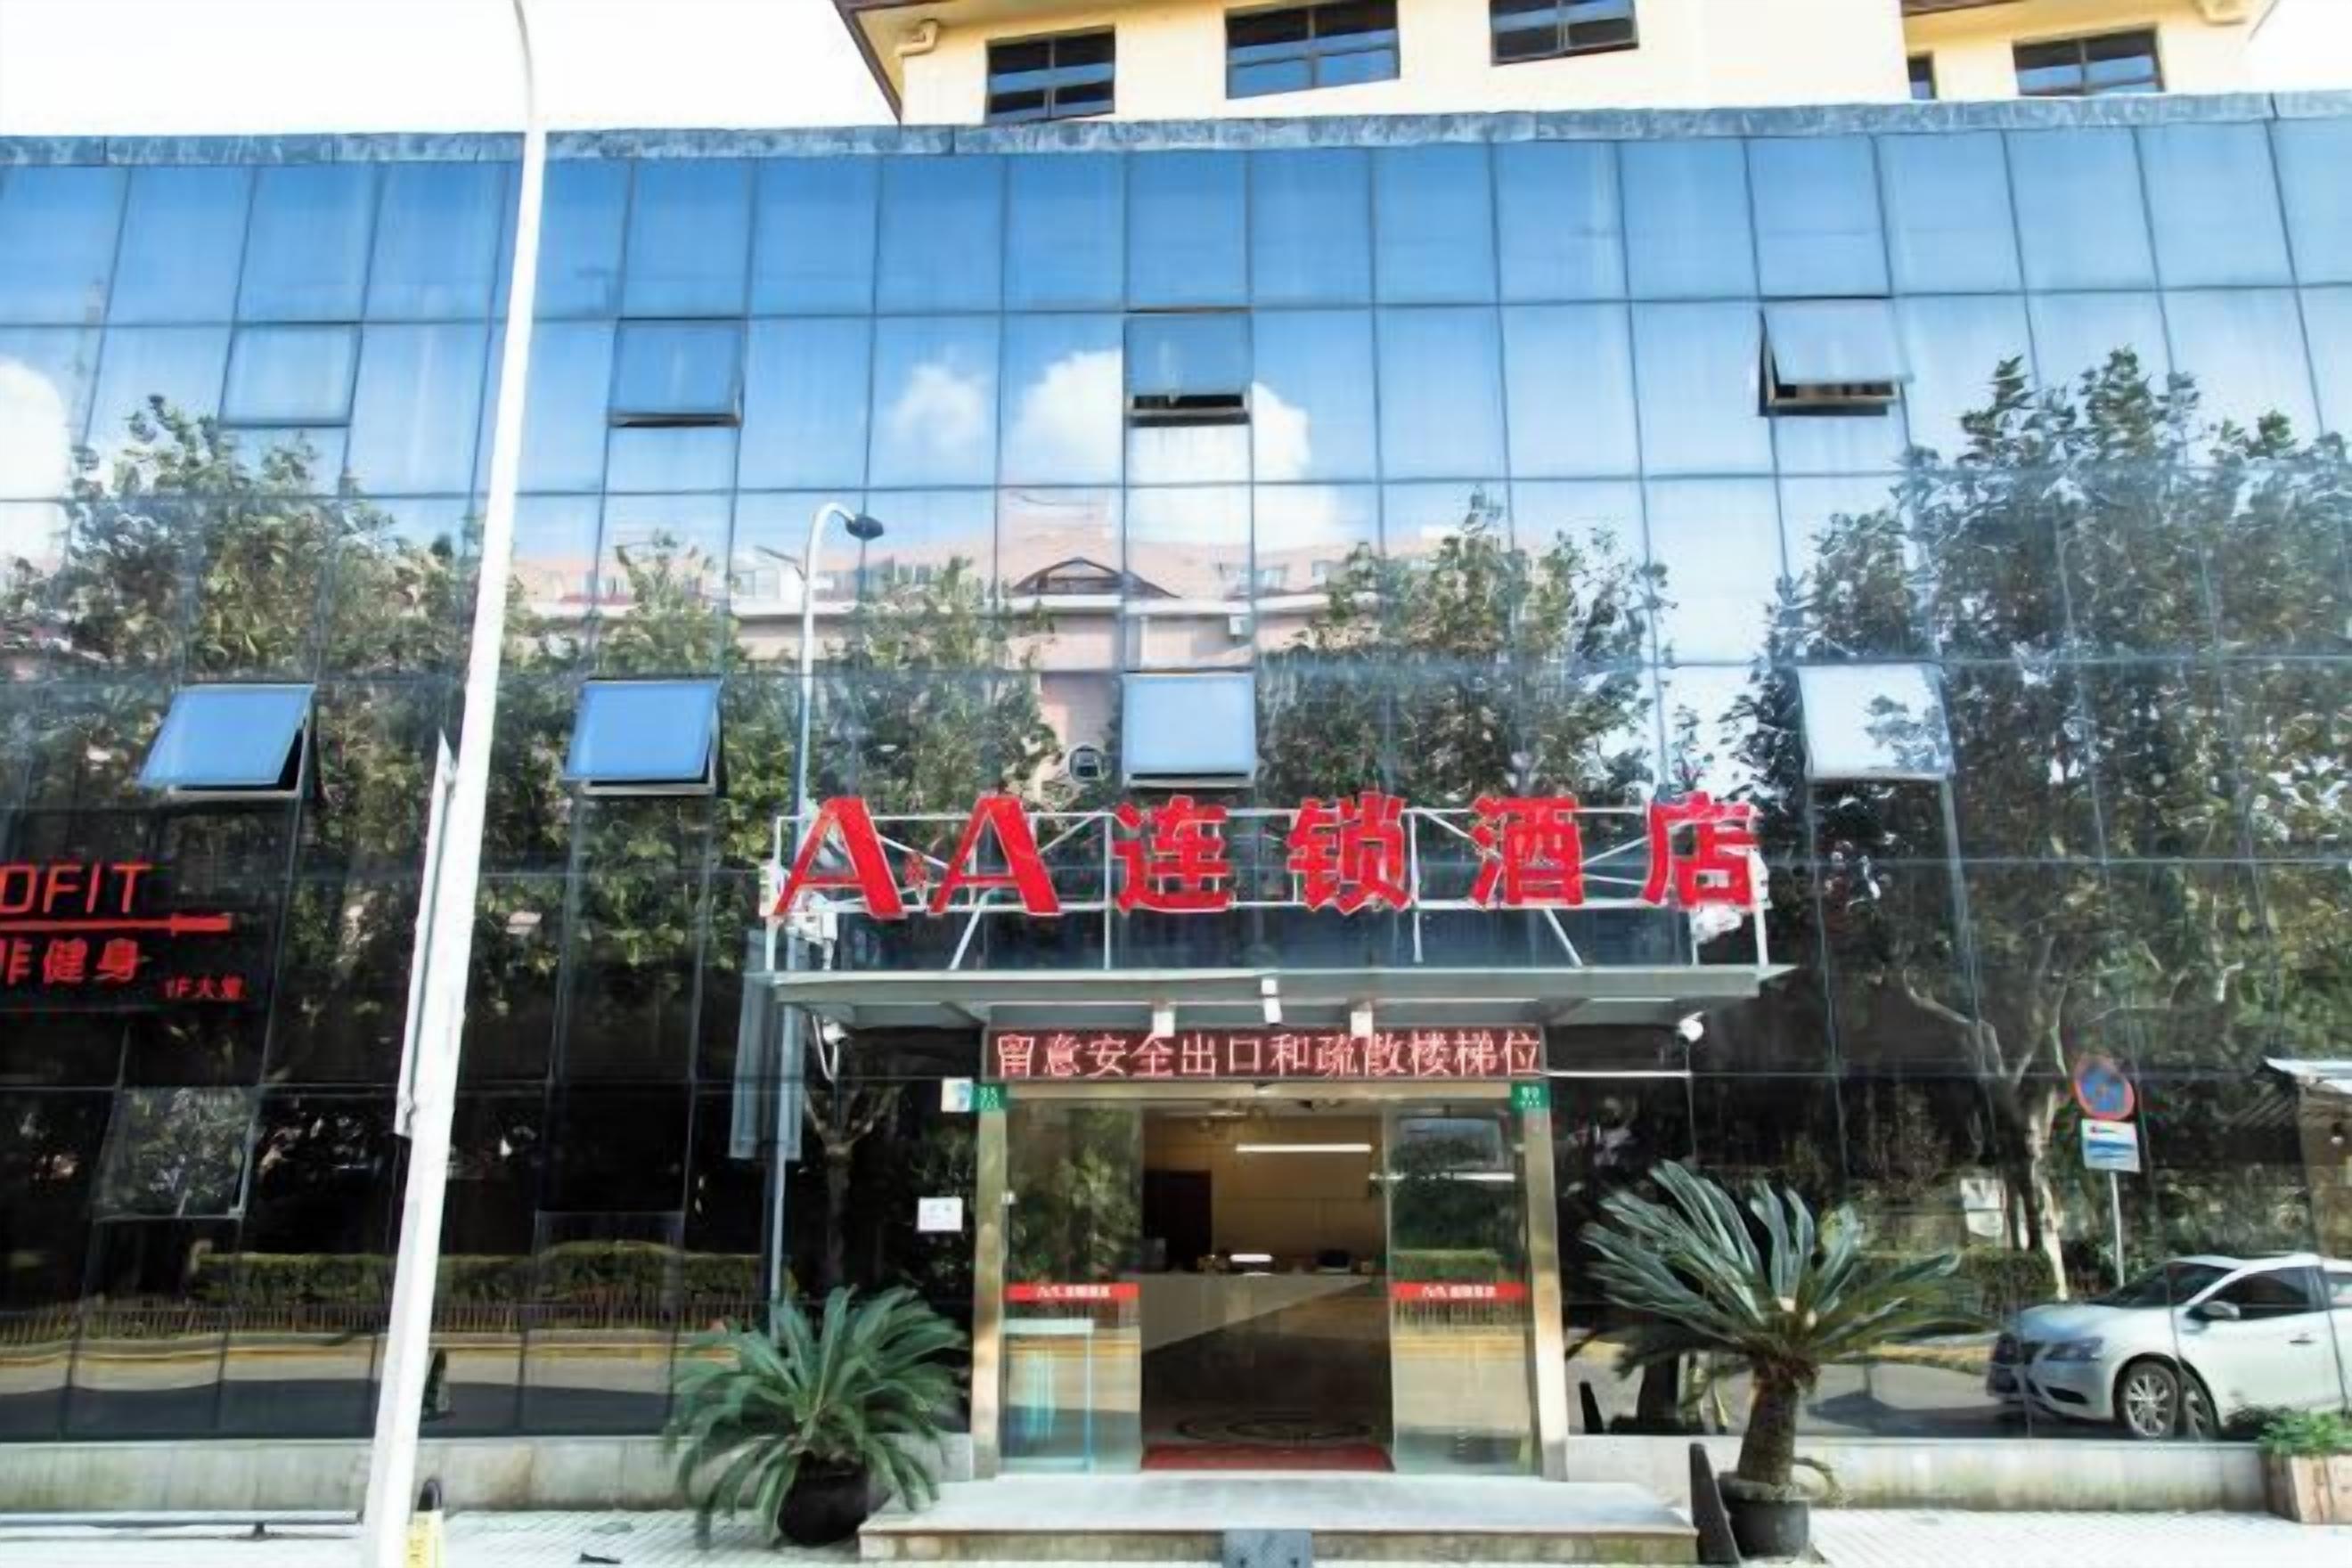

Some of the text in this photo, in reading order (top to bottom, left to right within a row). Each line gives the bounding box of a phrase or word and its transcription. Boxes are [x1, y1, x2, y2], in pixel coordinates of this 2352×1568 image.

[773, 792, 1756, 917] AA连锁酒店
[997, 1031, 1540, 1077] 留意安全出口和疏散楼梯位
